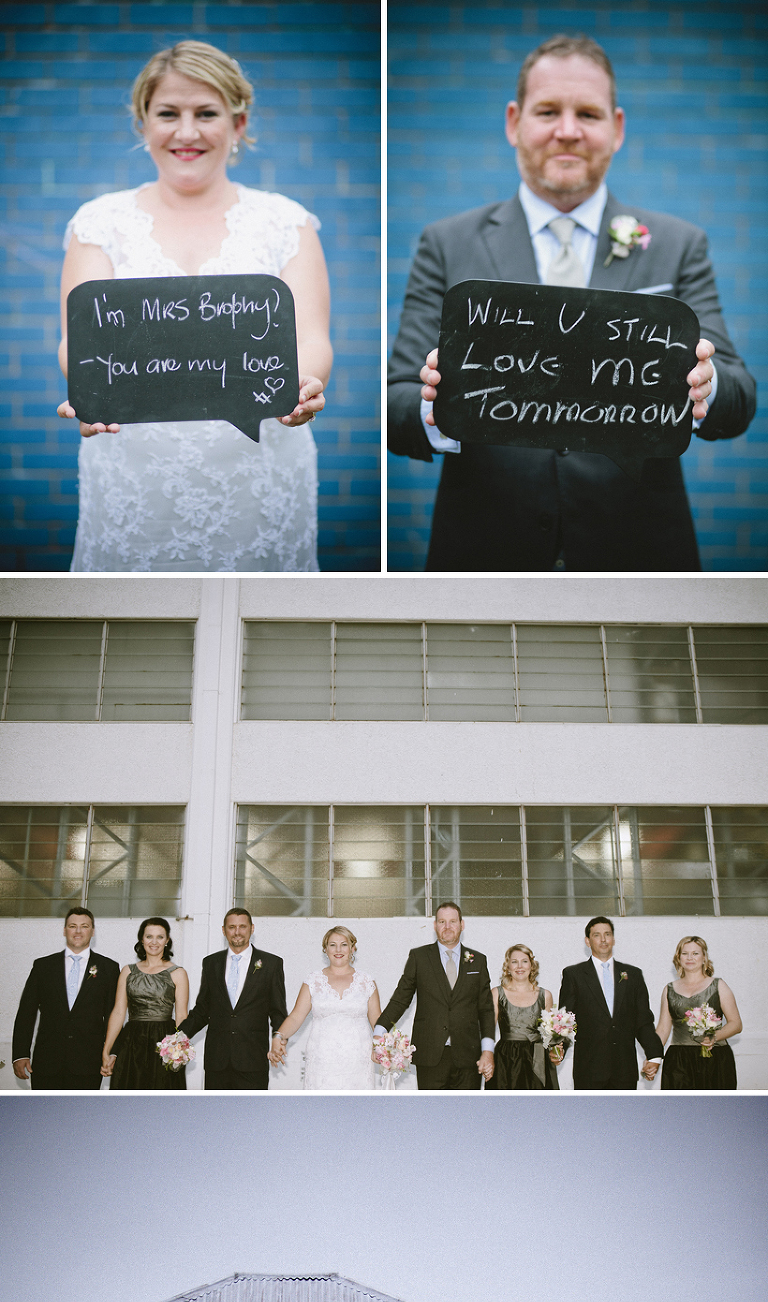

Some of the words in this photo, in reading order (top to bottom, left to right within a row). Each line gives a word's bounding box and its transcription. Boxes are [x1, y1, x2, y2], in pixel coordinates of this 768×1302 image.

[94, 293, 126, 328] I'm
[559, 302, 586, 334] U
[146, 358, 182, 374] are
[188, 359, 227, 389] my
